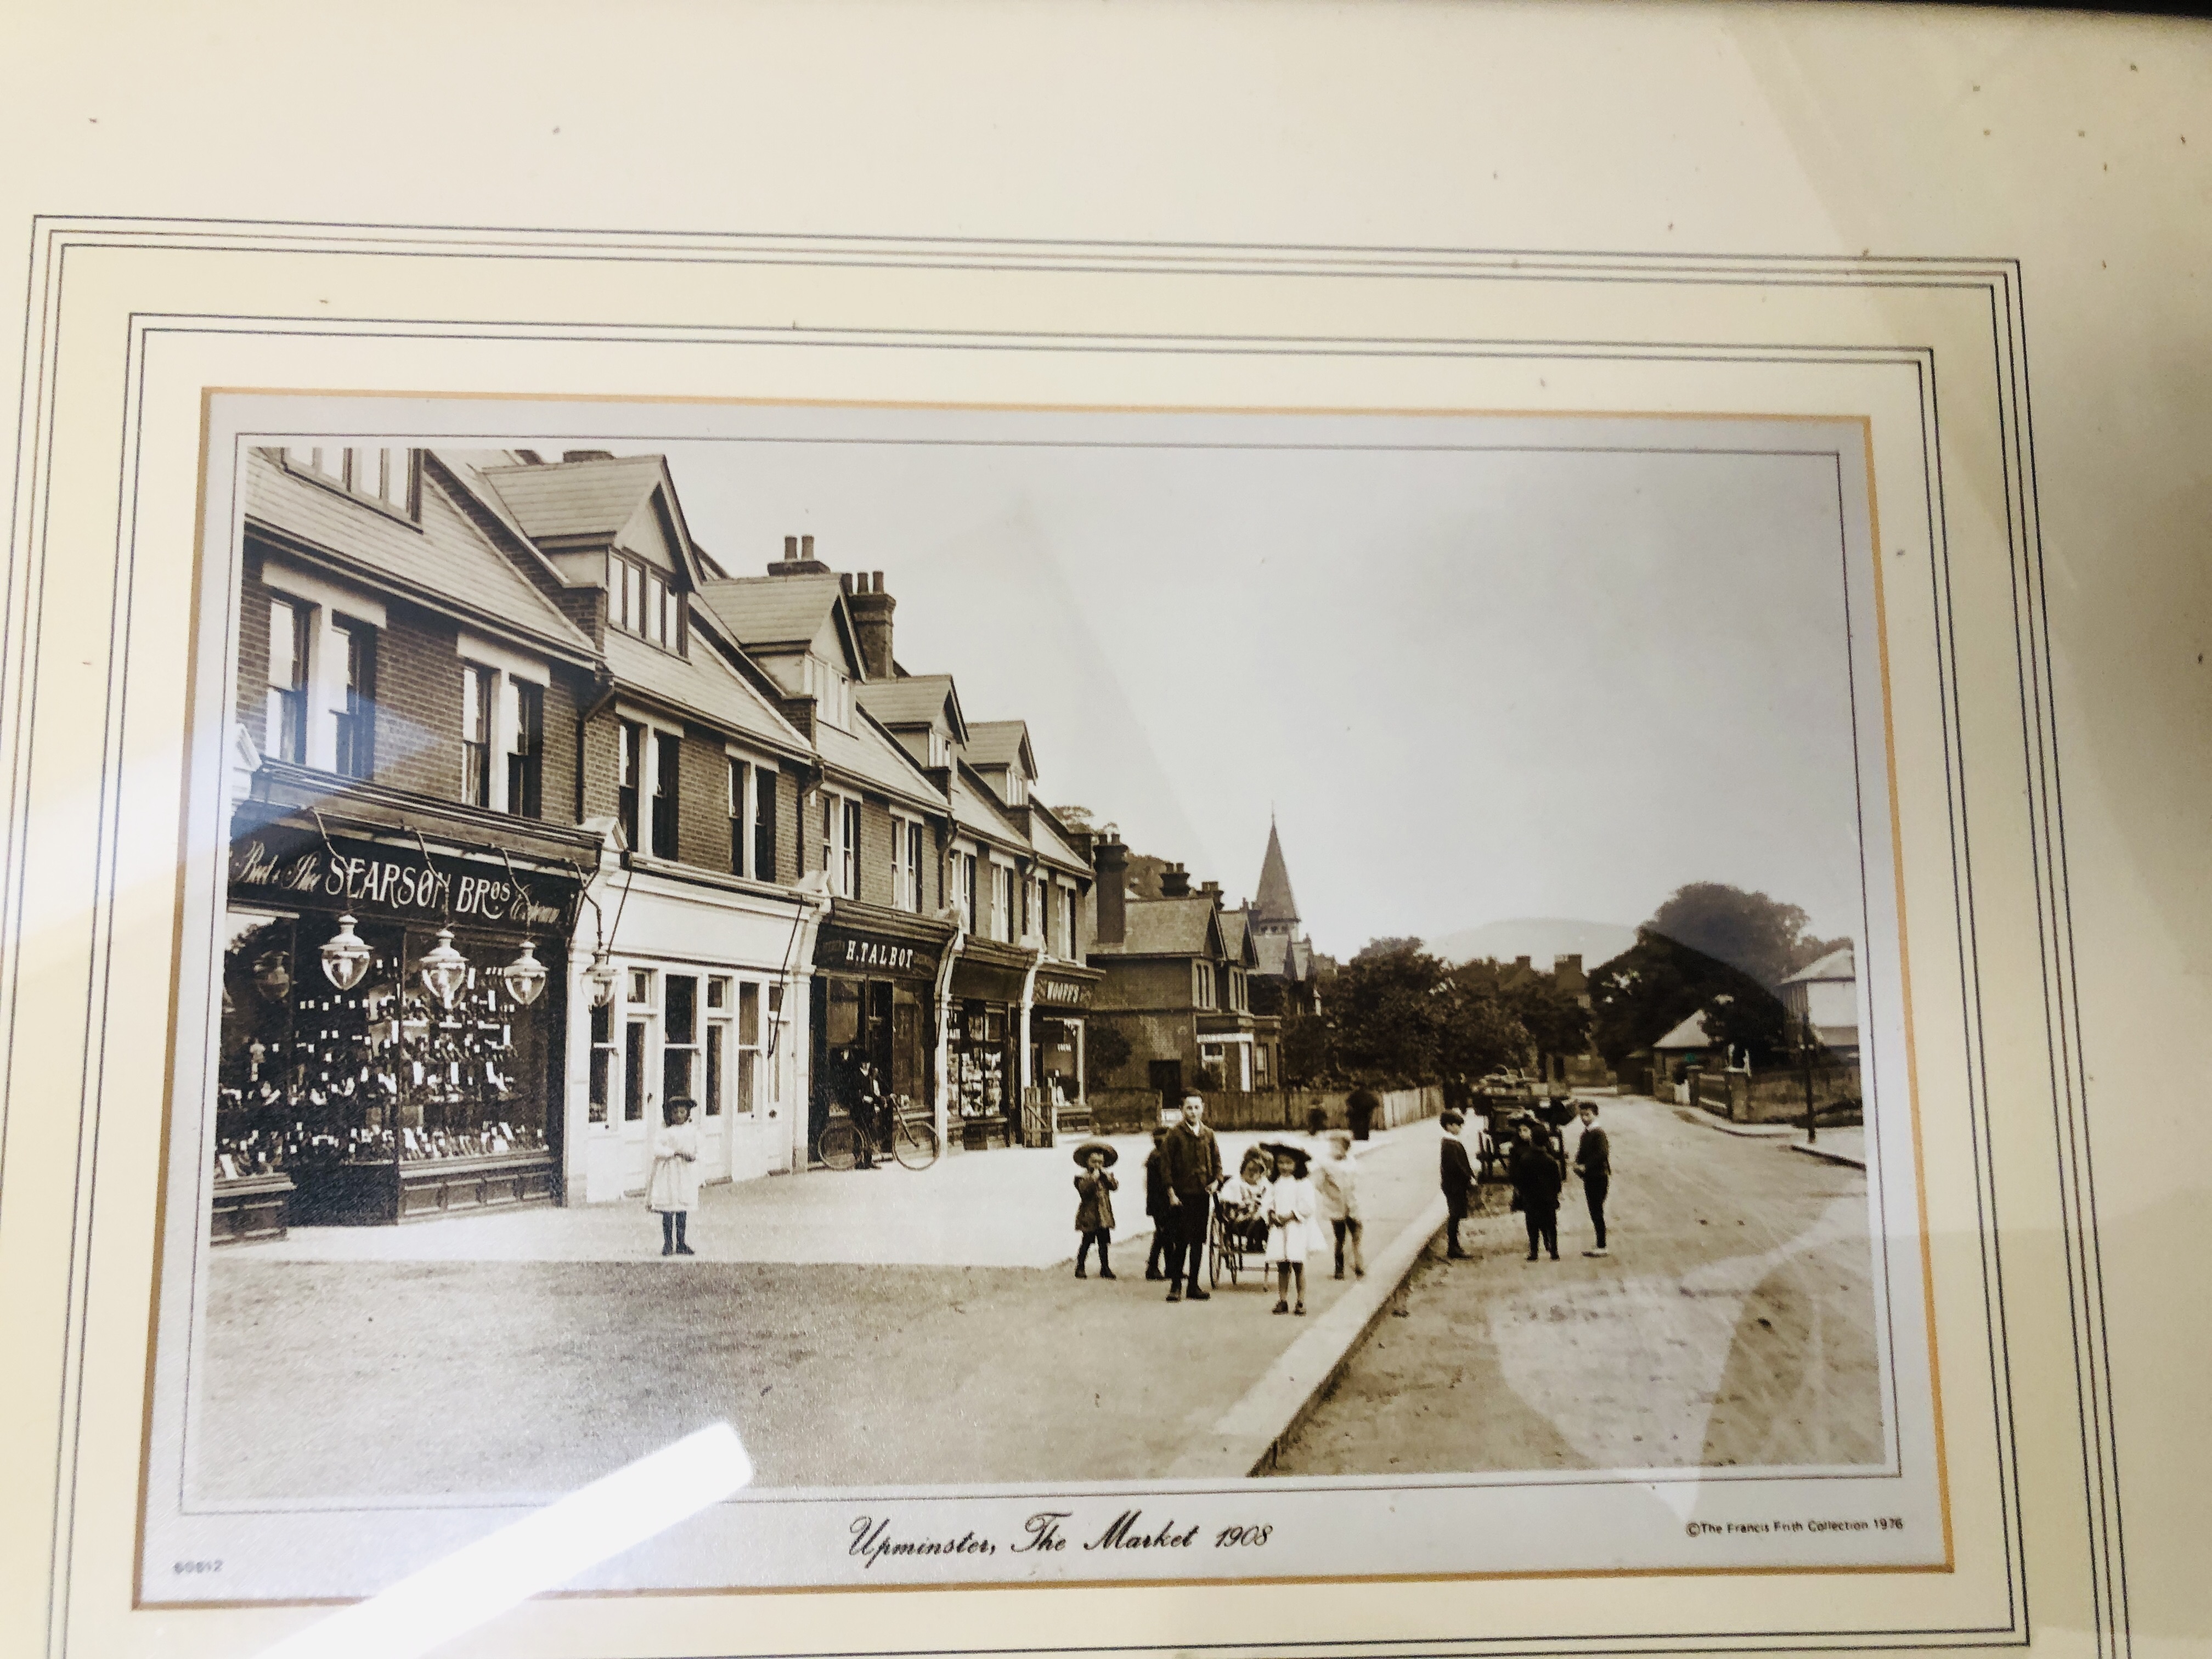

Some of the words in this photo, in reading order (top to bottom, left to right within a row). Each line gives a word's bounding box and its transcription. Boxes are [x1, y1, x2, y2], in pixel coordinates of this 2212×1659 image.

[325, 858, 451, 909] SEARSON
[849, 1515, 996, 1570] Upminster,
[1011, 1511, 1073, 1553] The
[1084, 1509, 1200, 1550] Market
[1214, 1525, 1273, 1548] 1908
[1726, 1521, 1769, 1533] Francis
[1773, 1520, 1803, 1532] Frith
[1808, 1520, 1869, 1532] Collection
